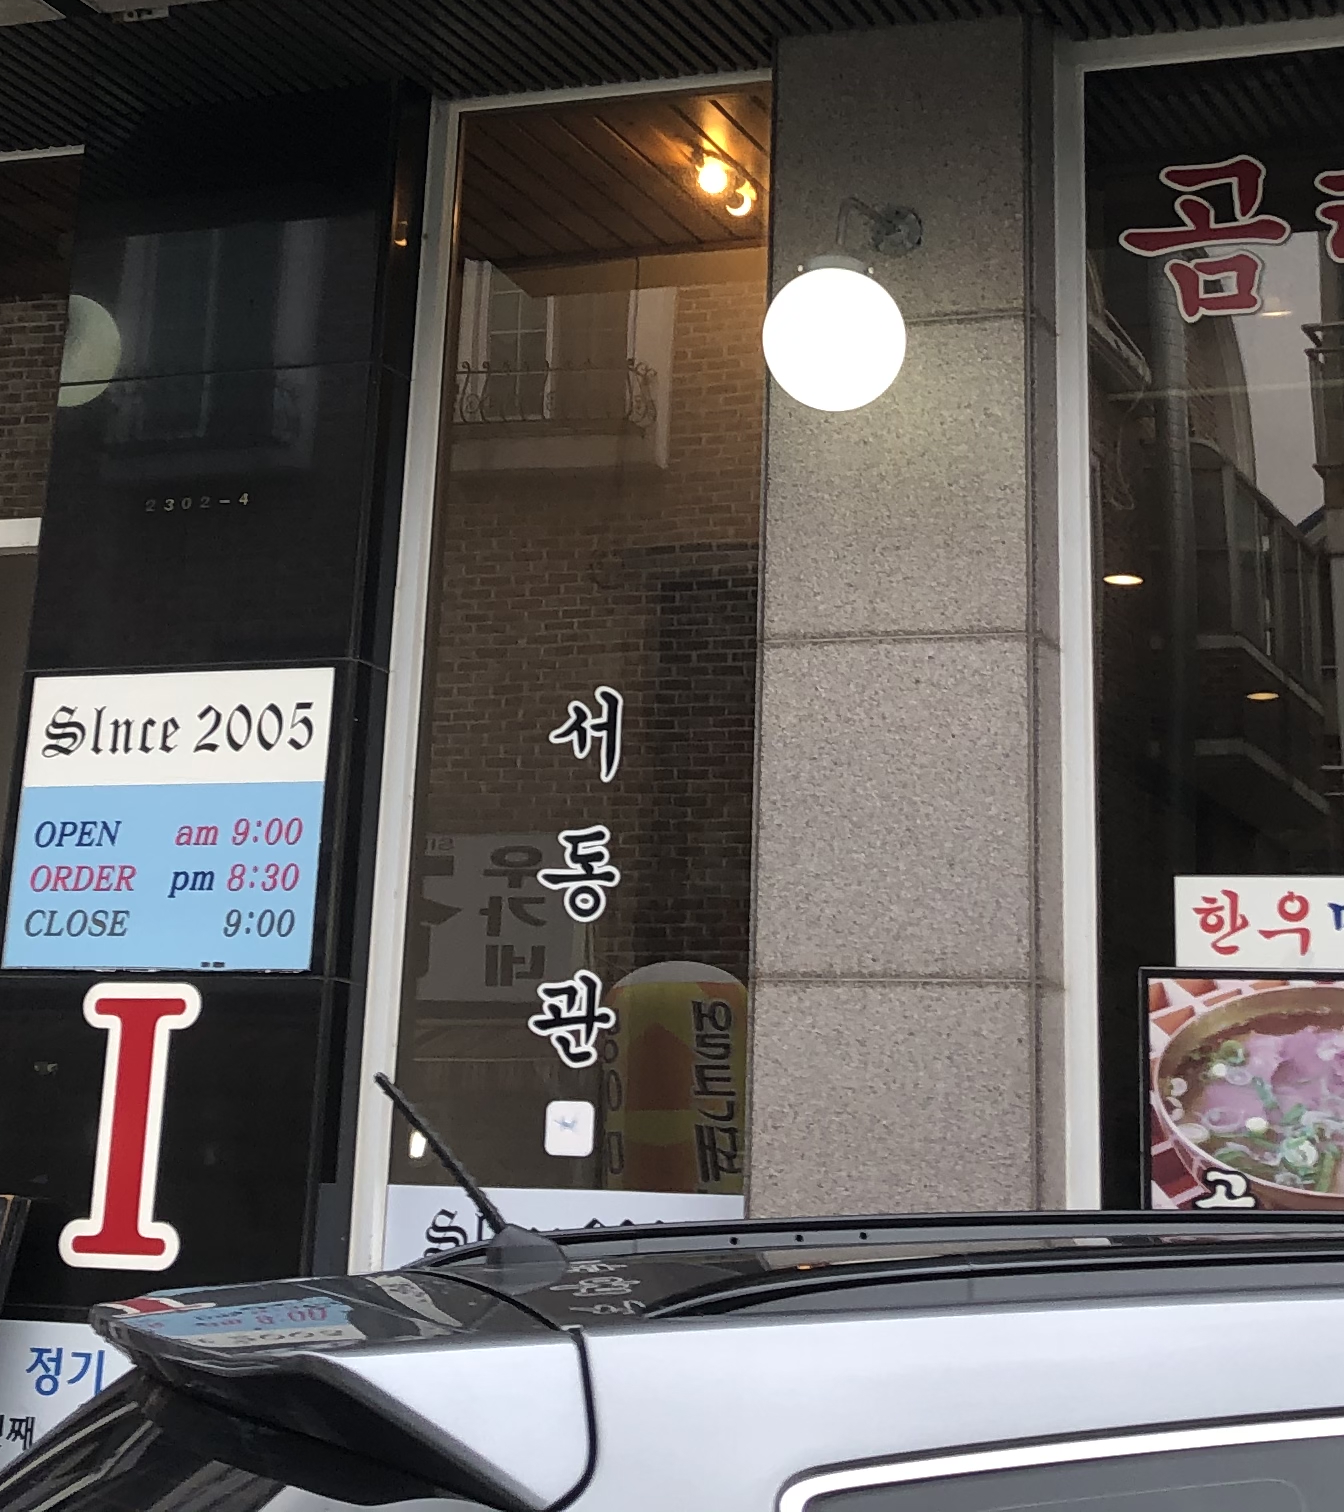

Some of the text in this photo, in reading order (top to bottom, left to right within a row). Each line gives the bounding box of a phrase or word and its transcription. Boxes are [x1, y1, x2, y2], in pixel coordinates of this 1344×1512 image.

[144, 491, 250, 513] 2302-4
[192, 701, 315, 754] 2005
[34, 817, 304, 848] OPEN am 9:00
[29, 862, 300, 899] ORDER pm 8:30
[528, 686, 624, 1069] 서동관
[24, 908, 296, 939] CLOSE 9:00
[25, 1347, 106, 1397] 정기
